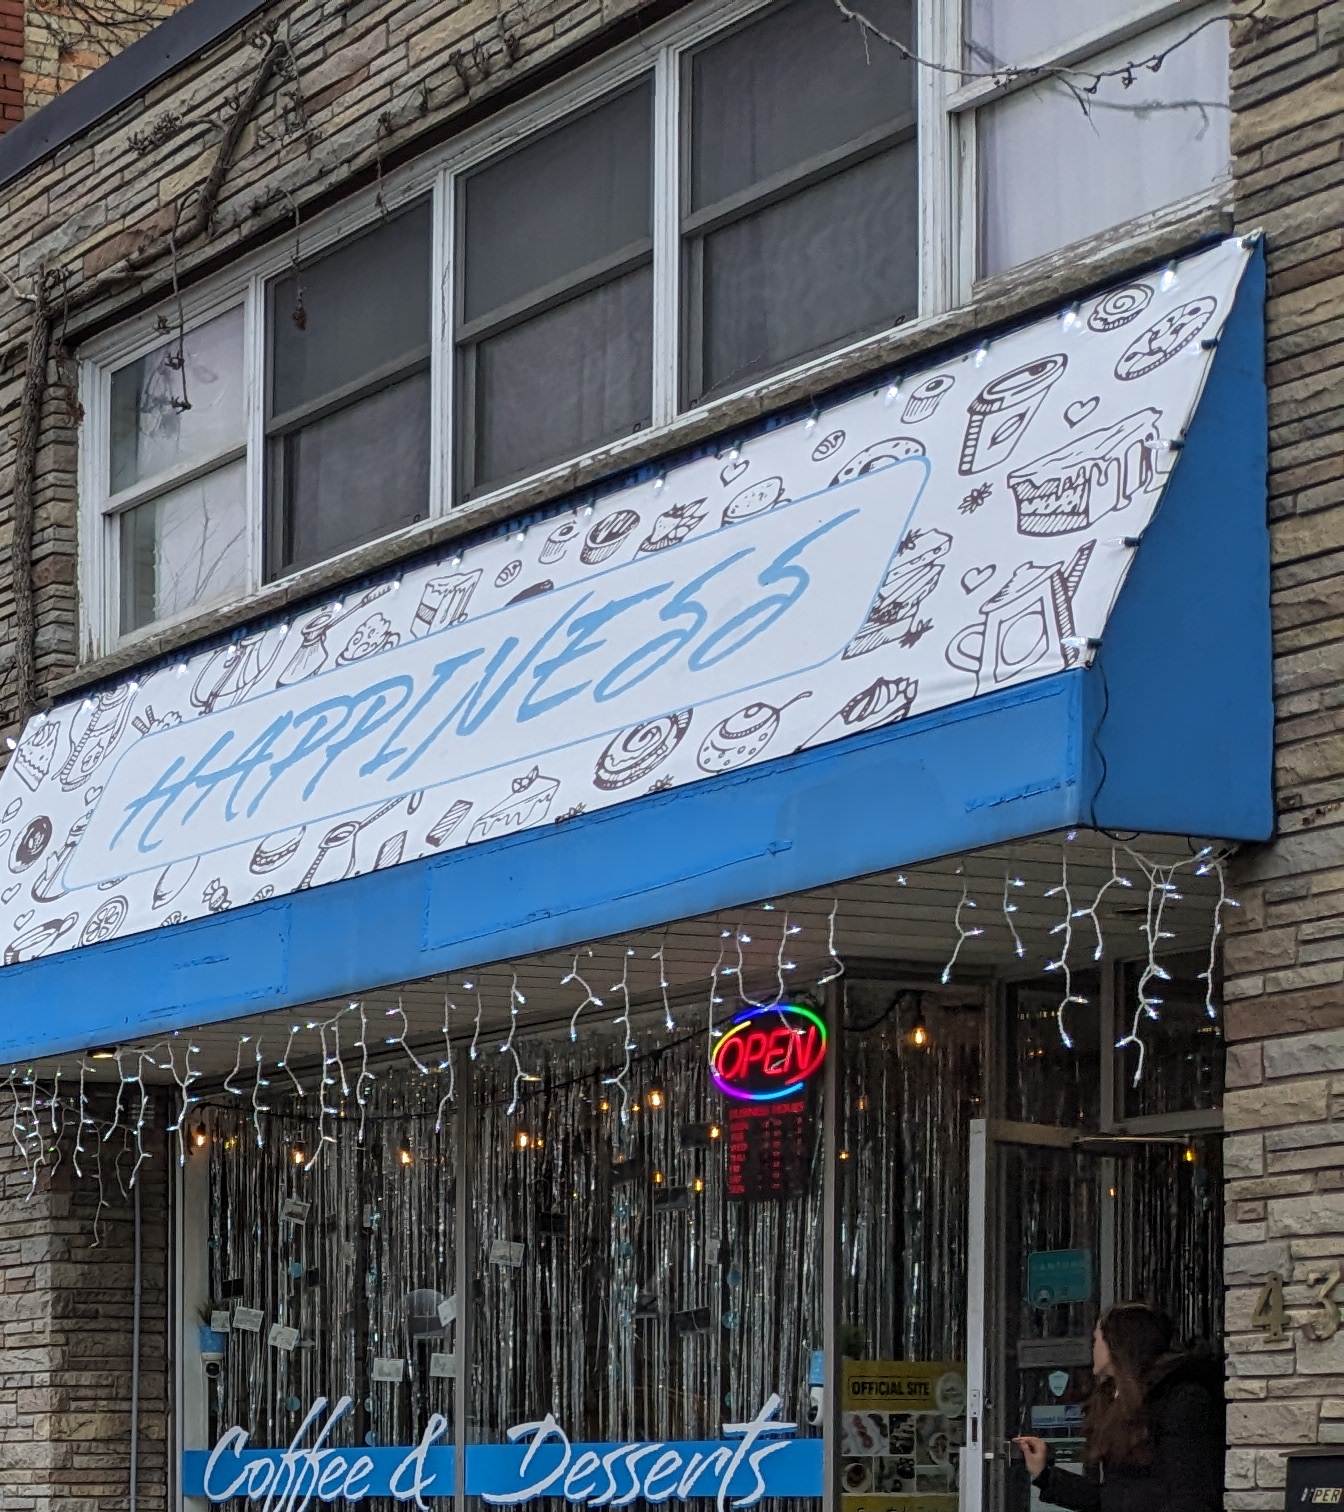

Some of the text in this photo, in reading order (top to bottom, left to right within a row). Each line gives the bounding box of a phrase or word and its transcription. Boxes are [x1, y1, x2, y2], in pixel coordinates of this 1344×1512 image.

[109, 507, 864, 852] HAPPINESS
[717, 1025, 817, 1080] OPEN
[1251, 1268, 1342, 1344] 43
[851, 1381, 931, 1396] OFFICIAL SITE
[389, 1412, 449, 1512] &
